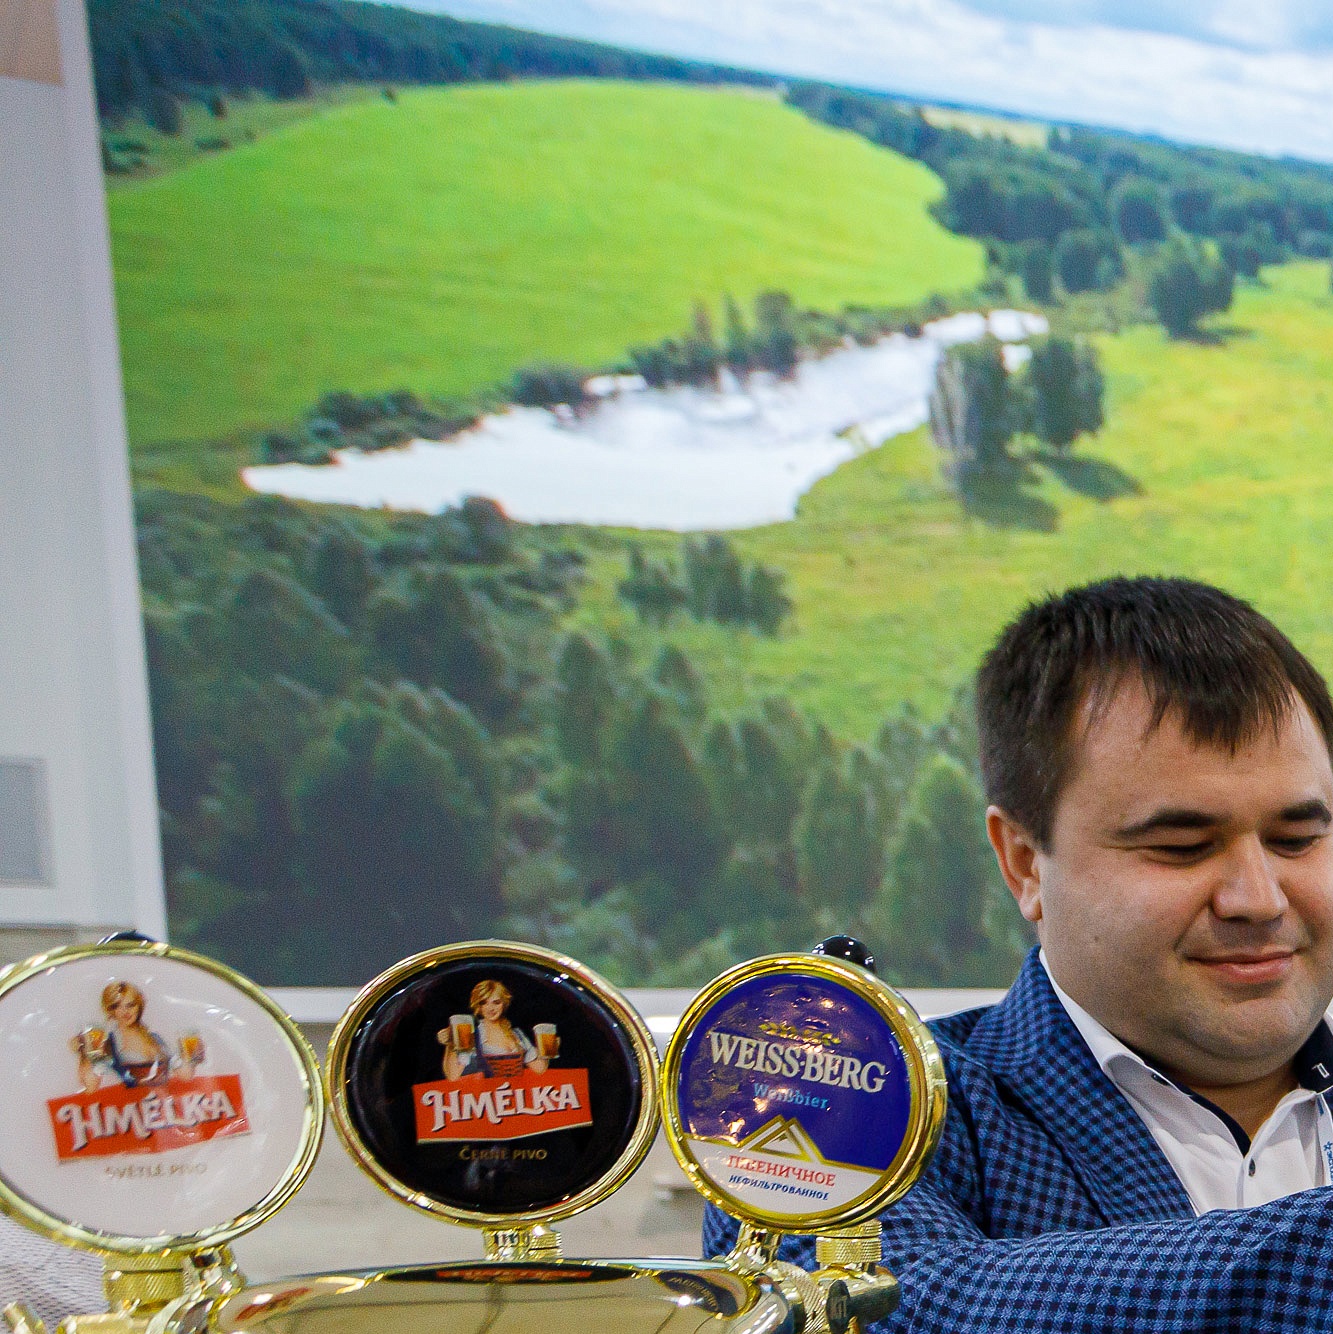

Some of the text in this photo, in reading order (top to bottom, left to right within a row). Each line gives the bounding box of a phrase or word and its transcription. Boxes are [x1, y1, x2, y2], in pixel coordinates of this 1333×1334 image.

[57, 1091, 238, 1151] HMÉLKA
[421, 1082, 582, 1132] HMÉLKA
[512, 1149, 547, 1160] PIVO
[728, 1155, 836, 1187] ПШЕНИЧНОЕ
[729, 1175, 830, 1200] НЕФИЛЬТРОВАННОЕ
